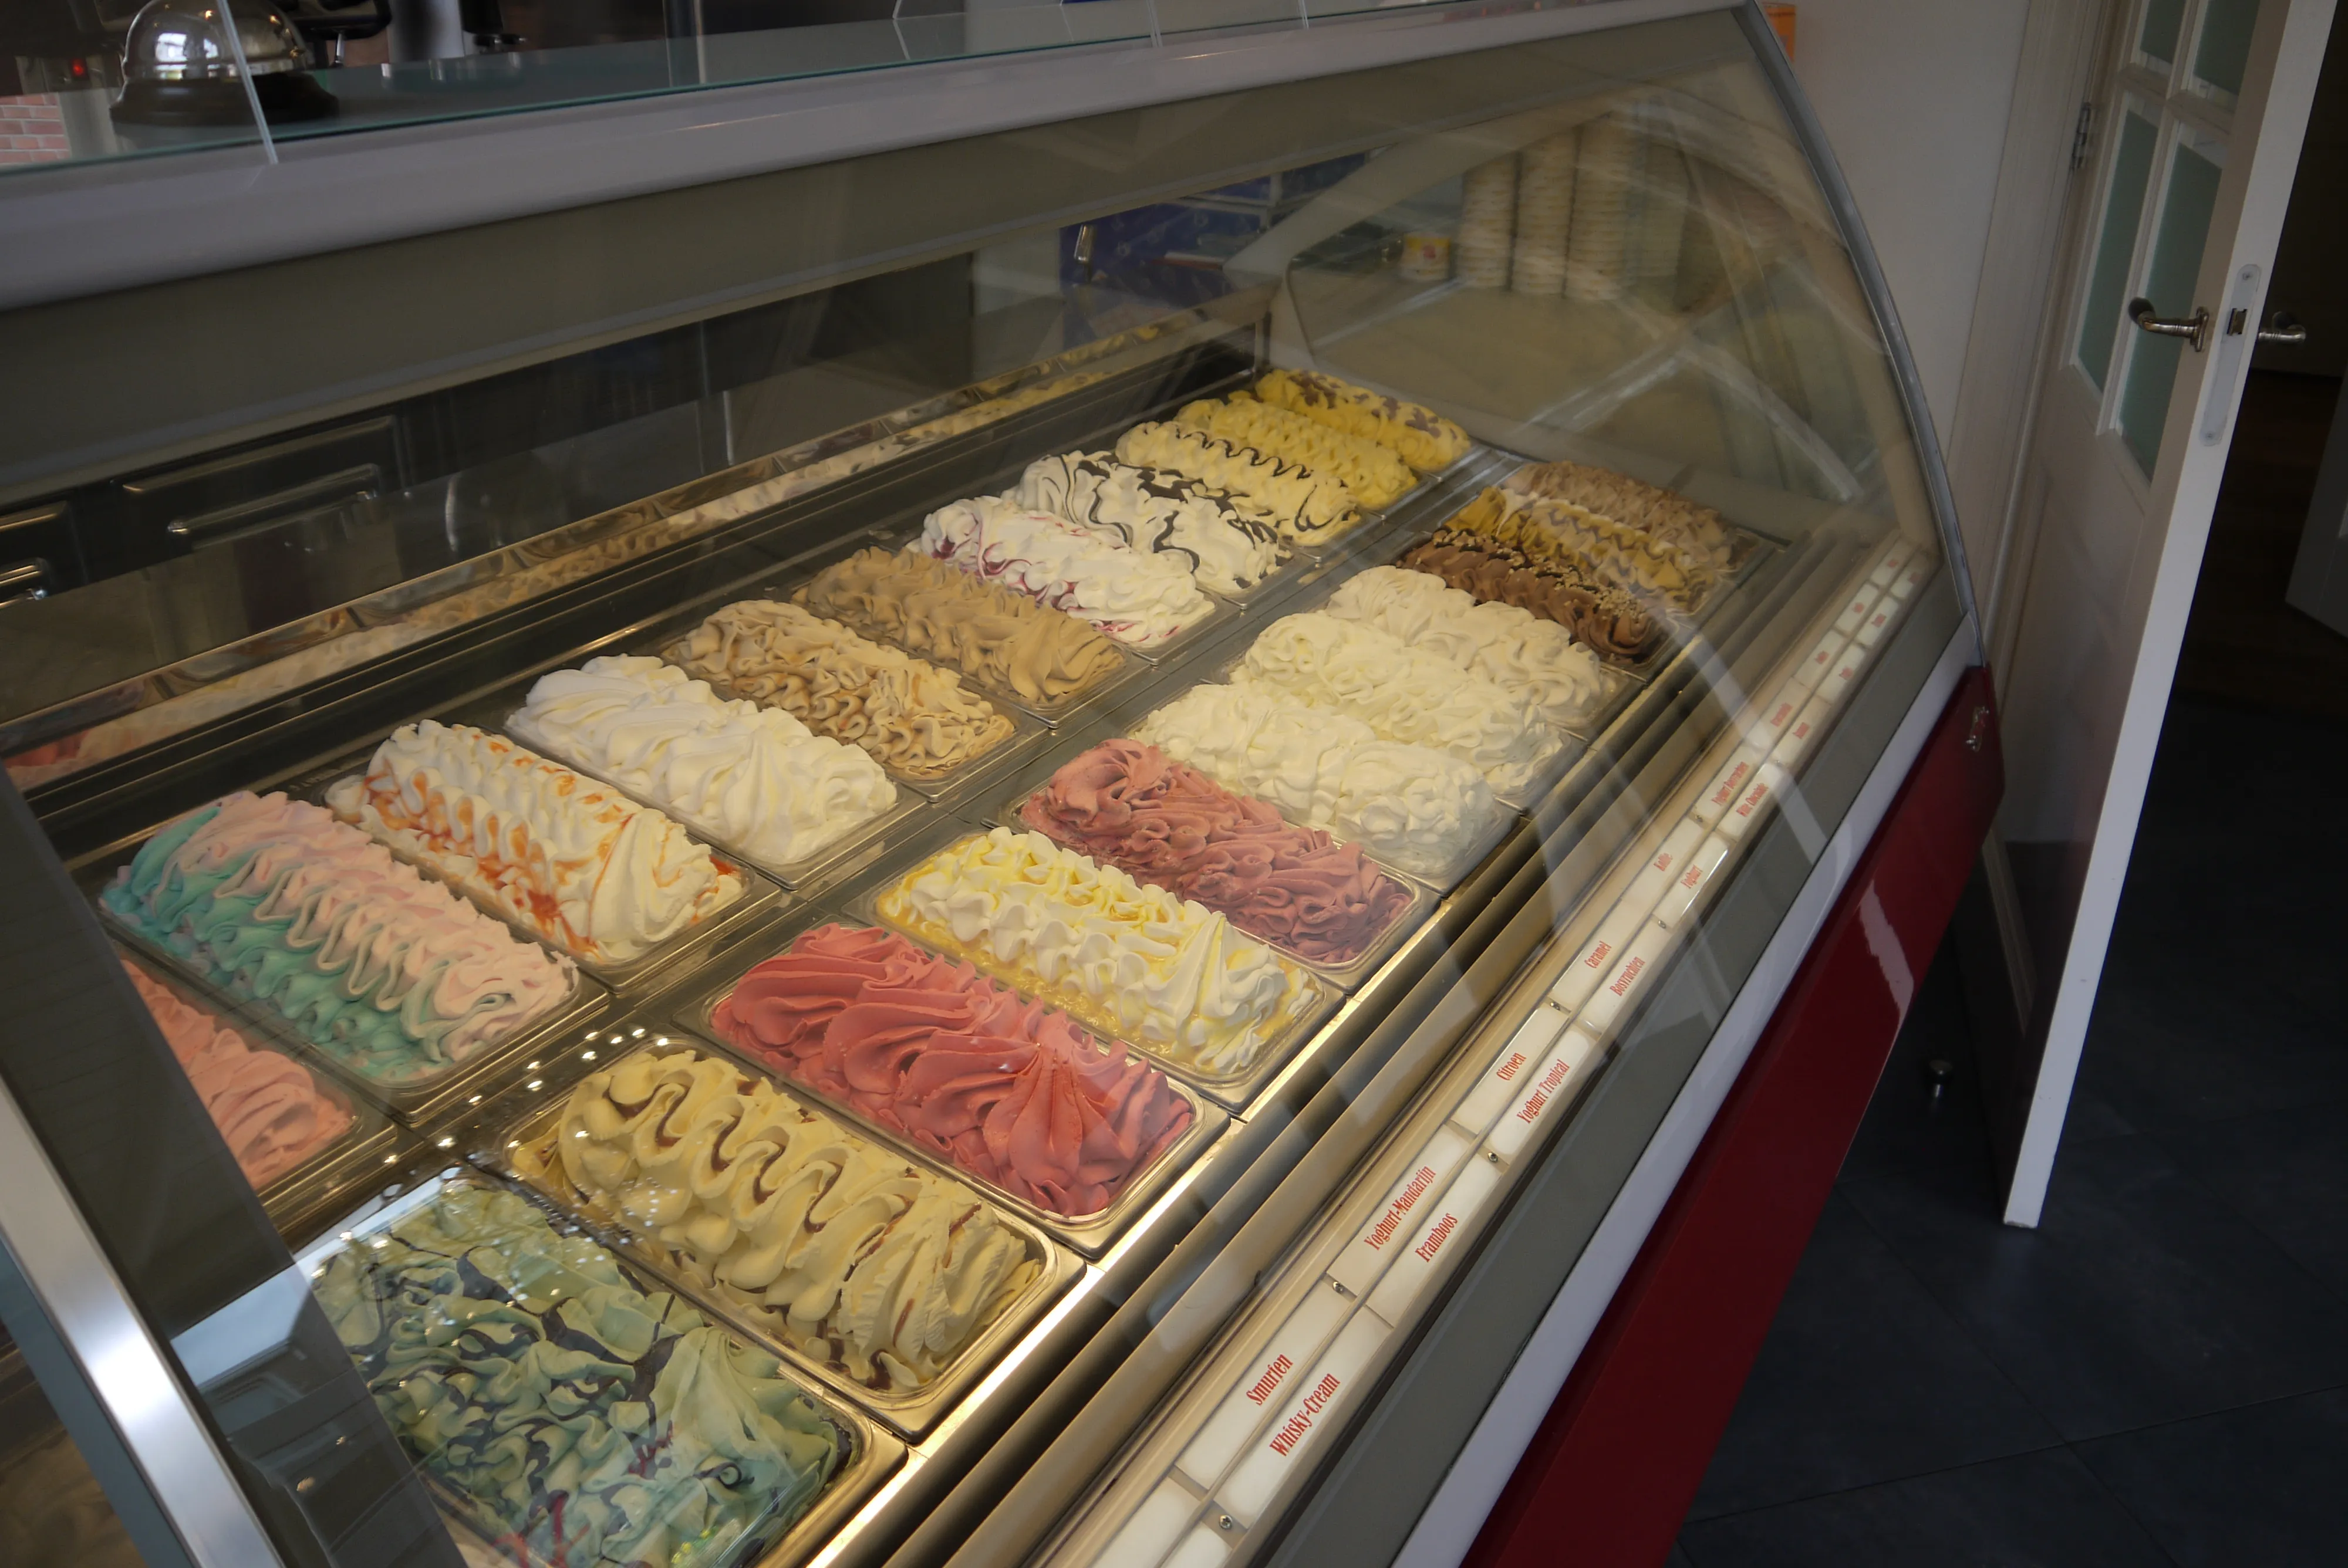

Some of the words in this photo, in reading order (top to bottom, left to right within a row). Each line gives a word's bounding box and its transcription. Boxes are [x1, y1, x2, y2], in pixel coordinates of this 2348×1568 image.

[1584, 940, 1612, 968] Caramel
[1610, 957, 1645, 996] Bosvruchten
[1496, 1052, 1526, 1081] Citroen
[1517, 1090, 1549, 1124] Yoghurt
[1539, 1059, 1570, 1094] Tropical
[1364, 1166, 1436, 1251] Yoghurt-Mandarijn
[1415, 1213, 1458, 1263] Framboos
[1246, 1354, 1293, 1406] Smurfen
[1269, 1373, 1341, 1457] Whisky-Cream
